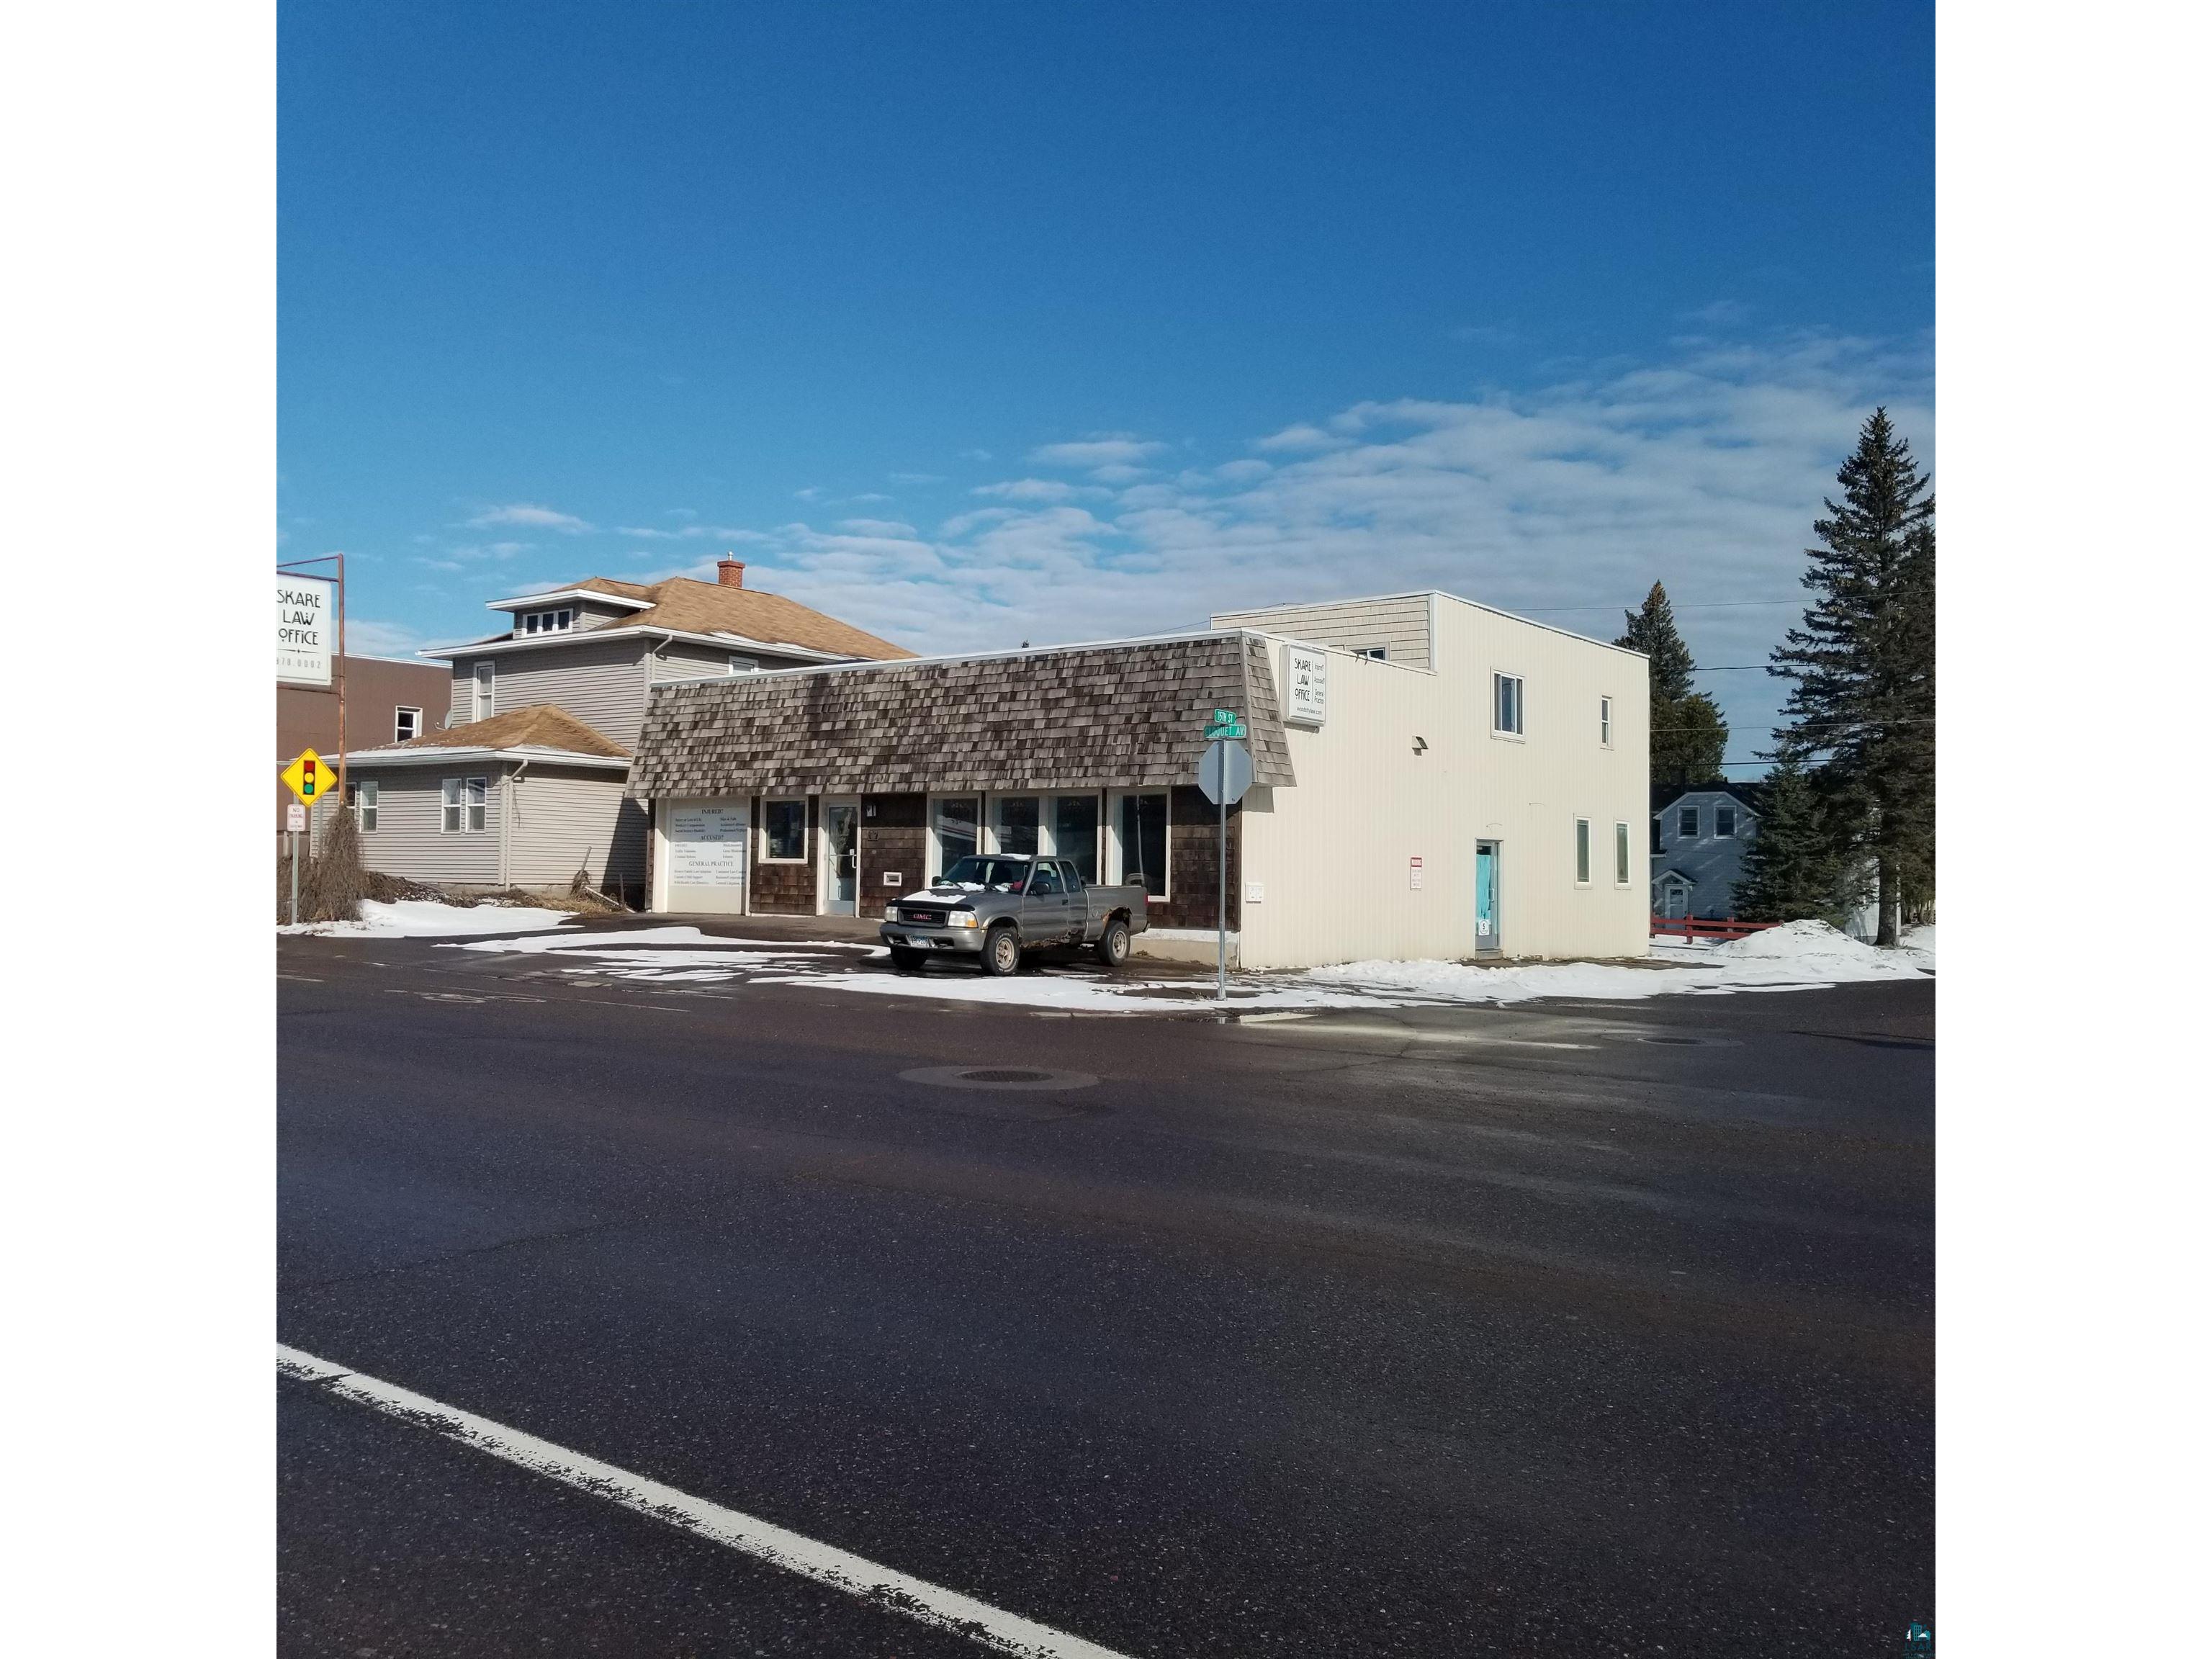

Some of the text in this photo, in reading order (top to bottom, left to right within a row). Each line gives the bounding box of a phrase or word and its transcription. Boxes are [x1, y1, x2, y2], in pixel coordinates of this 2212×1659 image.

[276, 590, 320, 608] SKARE
[283, 609, 315, 625] LAW
[279, 629, 318, 645] OFFICE
[1295, 658, 1311, 672] SKARE
[1297, 673, 1310, 685] LAW
[1295, 688, 1310, 701] OFFICE
[1218, 711, 1233, 723] 15TH ST
